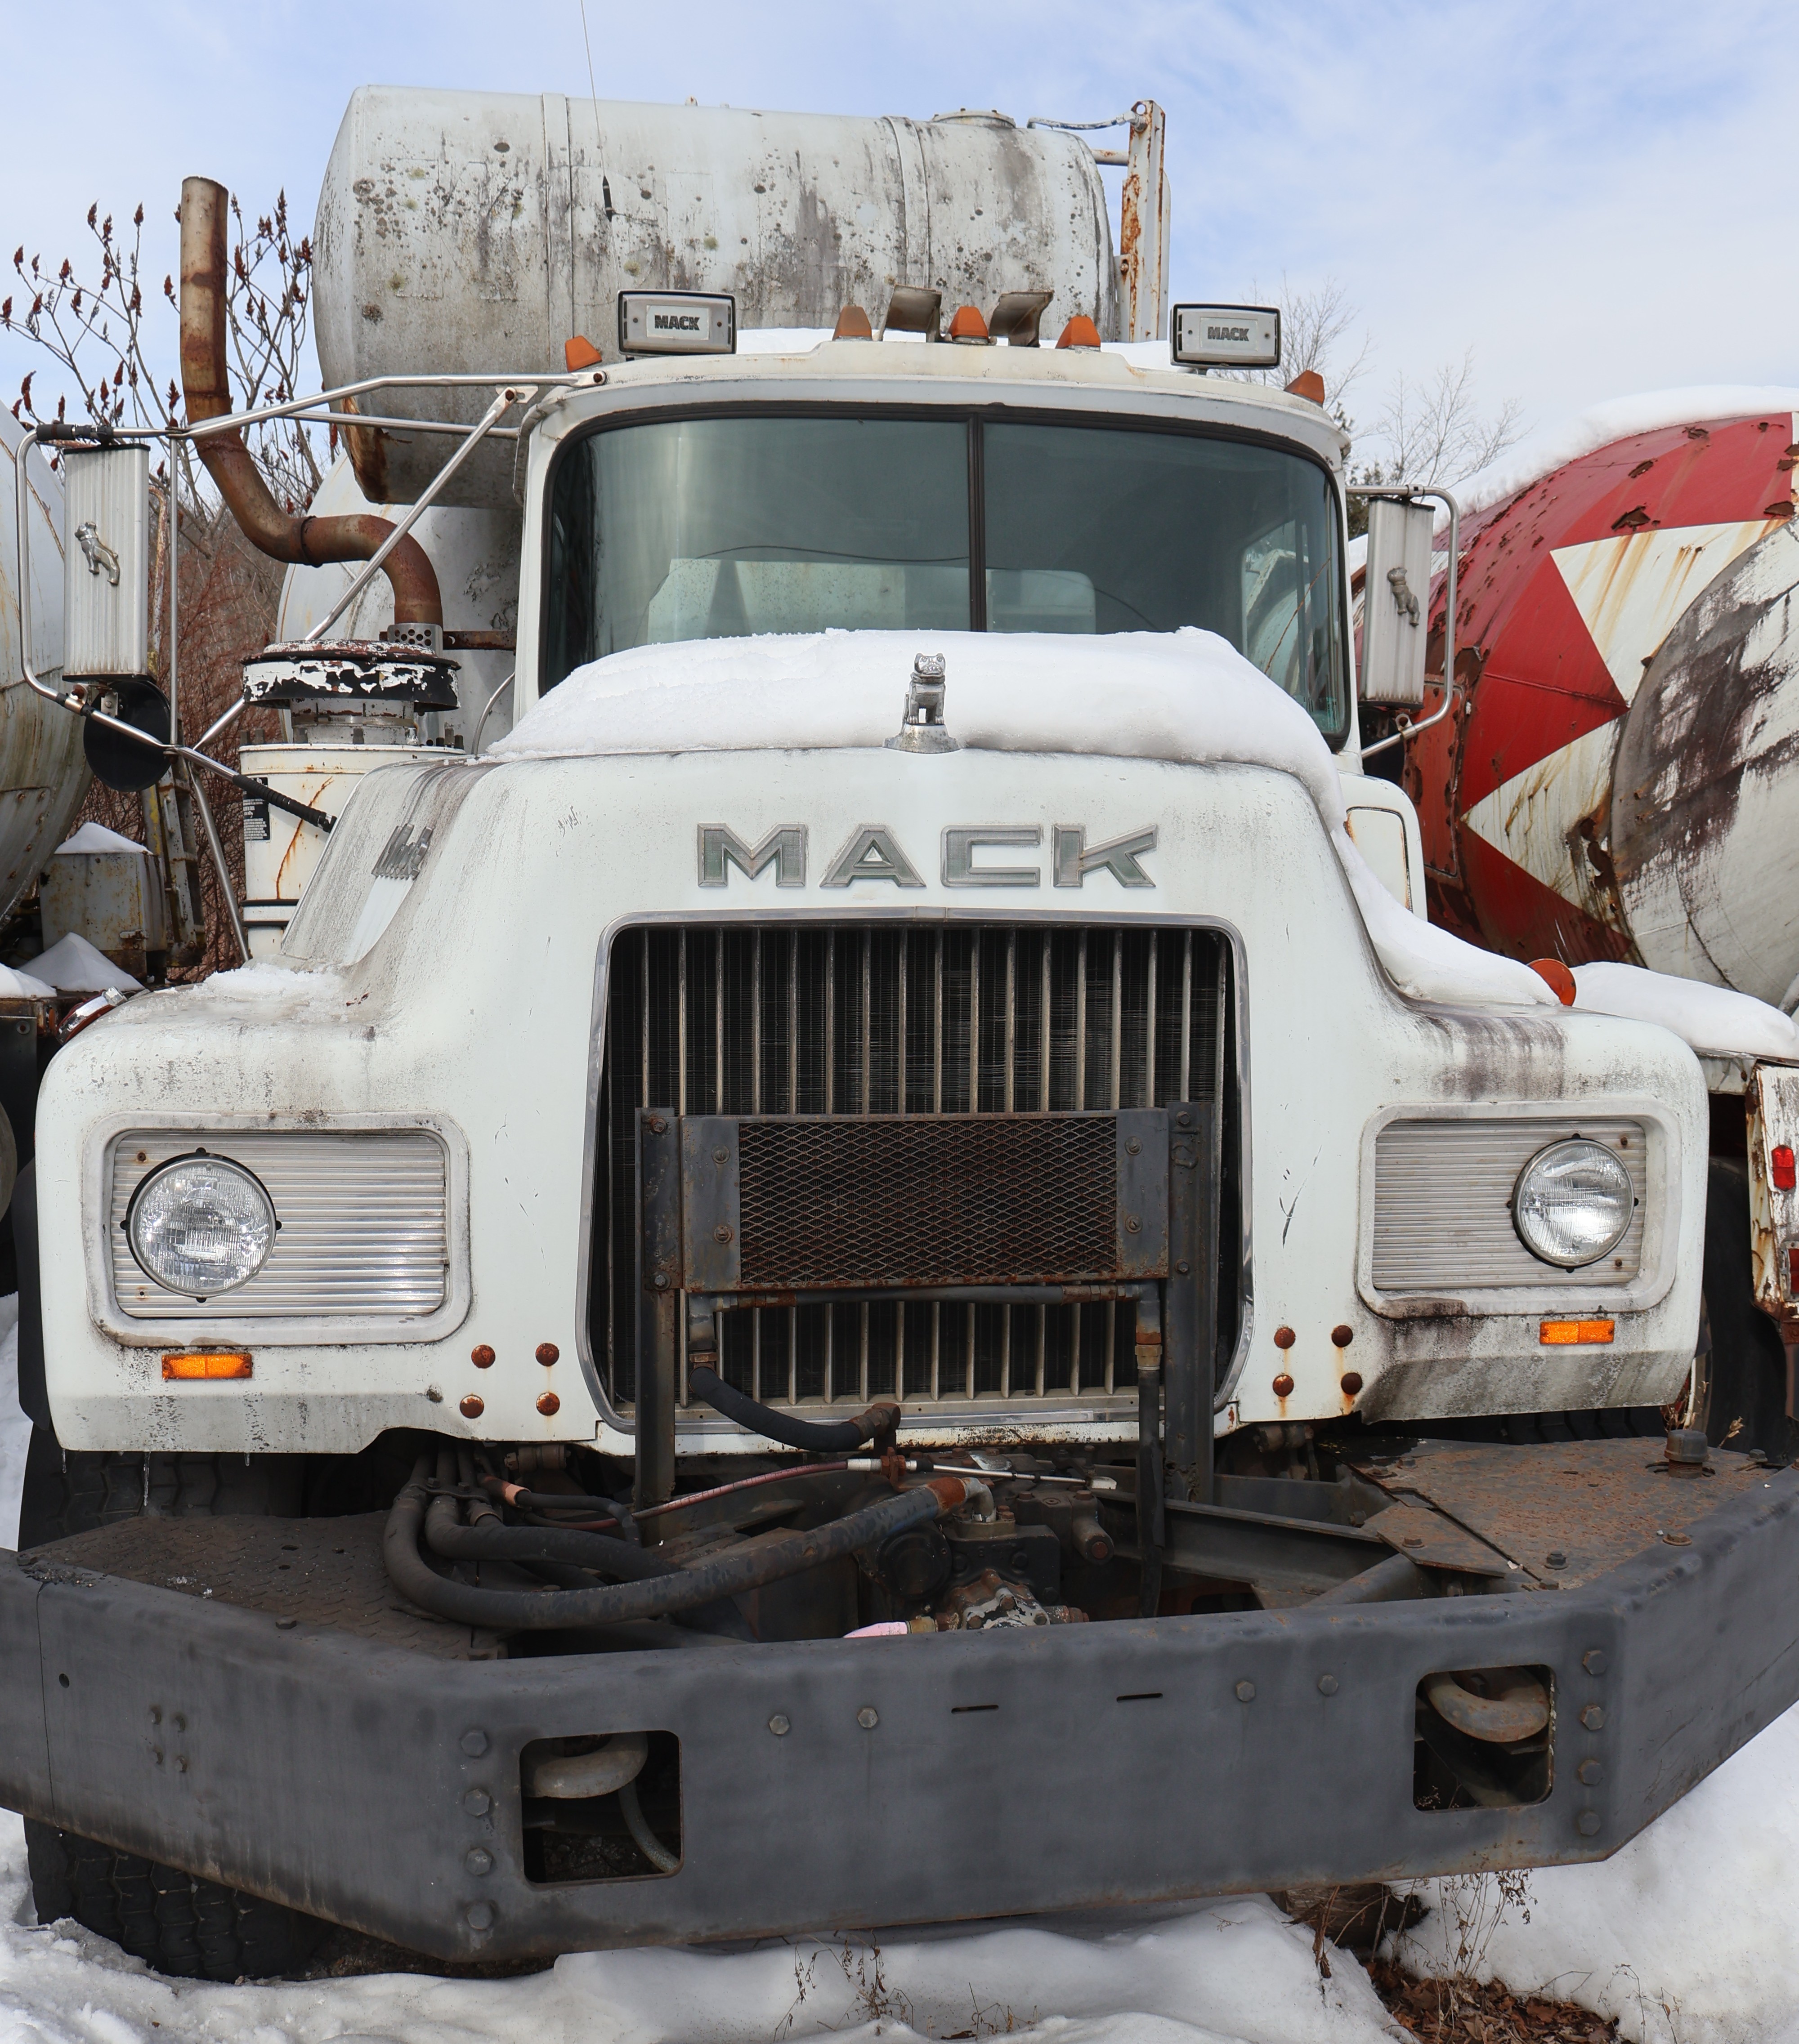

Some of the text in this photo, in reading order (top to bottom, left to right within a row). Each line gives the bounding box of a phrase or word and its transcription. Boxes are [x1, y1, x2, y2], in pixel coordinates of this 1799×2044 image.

[654, 315, 700, 330] MACK
[1208, 326, 1249, 341] MACK
[697, 822, 1158, 888] MACK
